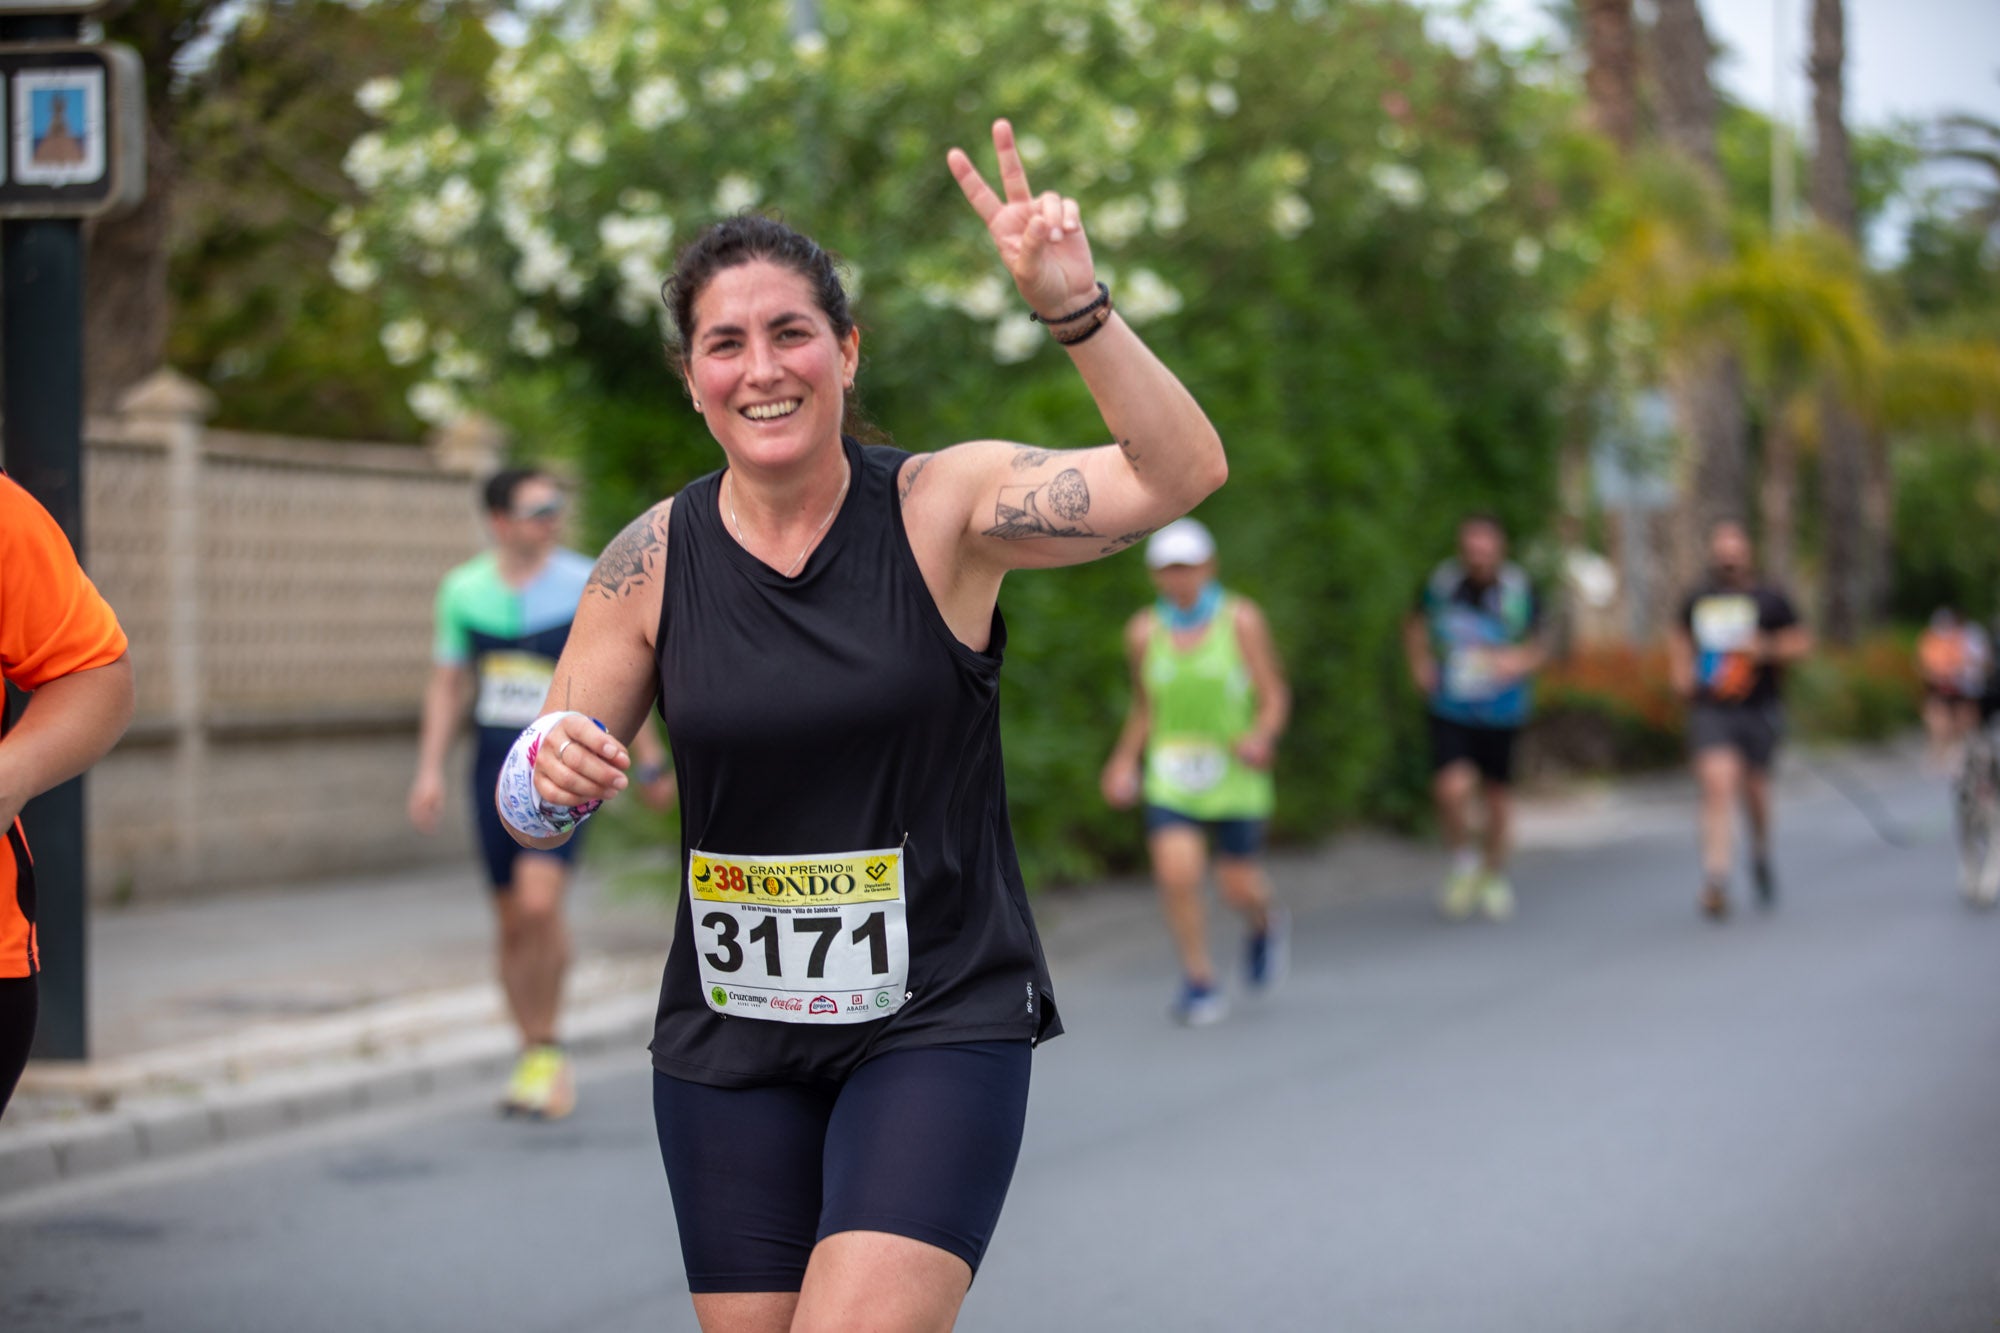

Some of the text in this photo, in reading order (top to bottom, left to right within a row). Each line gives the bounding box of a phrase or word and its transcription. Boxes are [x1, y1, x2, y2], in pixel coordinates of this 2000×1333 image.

[749, 865, 786, 875] GRAN
[789, 863, 844, 875] PREMIO
[714, 865, 745, 892] 38
[745, 874, 856, 897] FONDO
[701, 911, 889, 979] 3171
[729, 991, 768, 1004] Cruzcampo
[846, 1004, 869, 1012] ABADES
